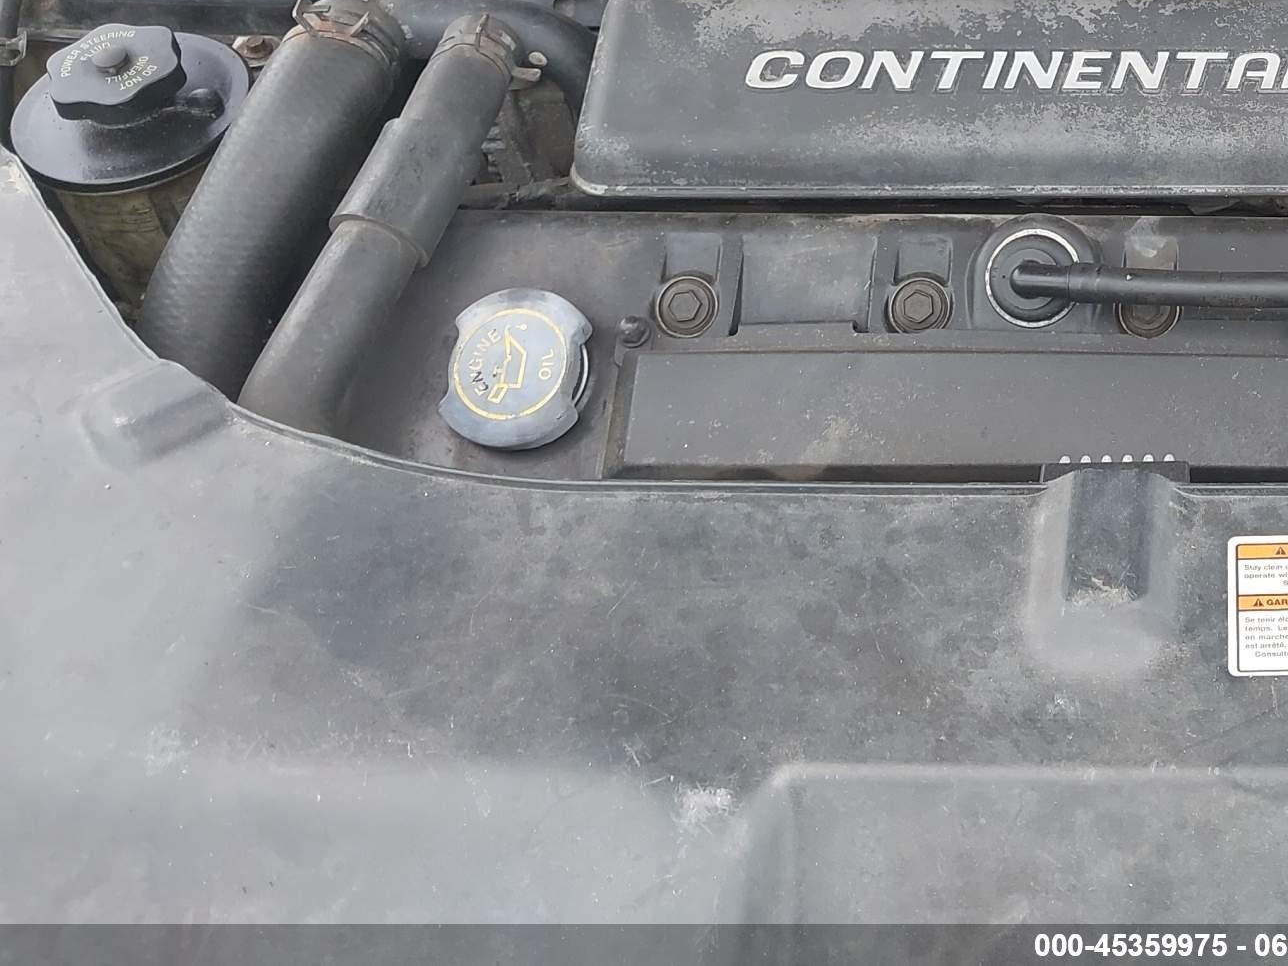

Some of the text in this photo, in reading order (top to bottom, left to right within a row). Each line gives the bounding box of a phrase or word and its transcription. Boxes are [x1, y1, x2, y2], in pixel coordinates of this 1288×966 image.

[60, 30, 136, 78] POWER STEERING
[80, 42, 111, 61] FLUID
[105, 56, 149, 85] OVERFILL
[119, 64, 157, 91] DO NOT
[467, 328, 502, 397] ENGINE
[538, 348, 555, 380] OIL
